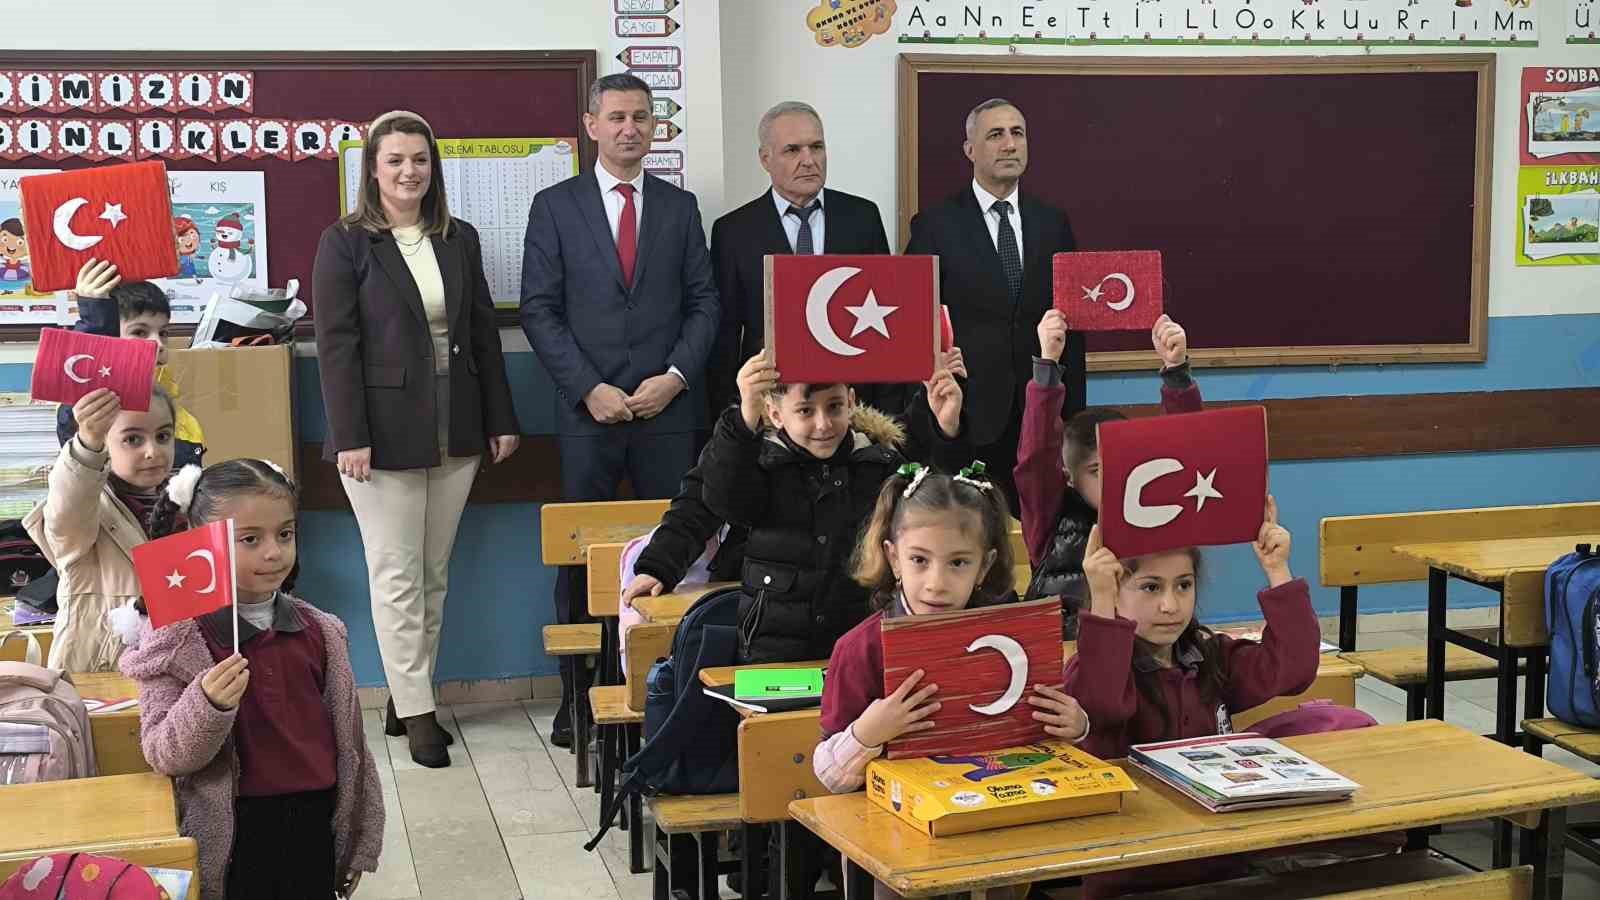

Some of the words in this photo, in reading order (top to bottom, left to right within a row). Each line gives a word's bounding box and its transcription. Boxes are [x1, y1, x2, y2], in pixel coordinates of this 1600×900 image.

[0, 75, 244, 102] İMİZİN
[0, 122, 350, 151] İNLİKLERİ
[479, 143, 524, 154] TABLOSU
[1545, 171, 1600, 186] İLKBAH
[209, 182, 228, 194] KIŞ
